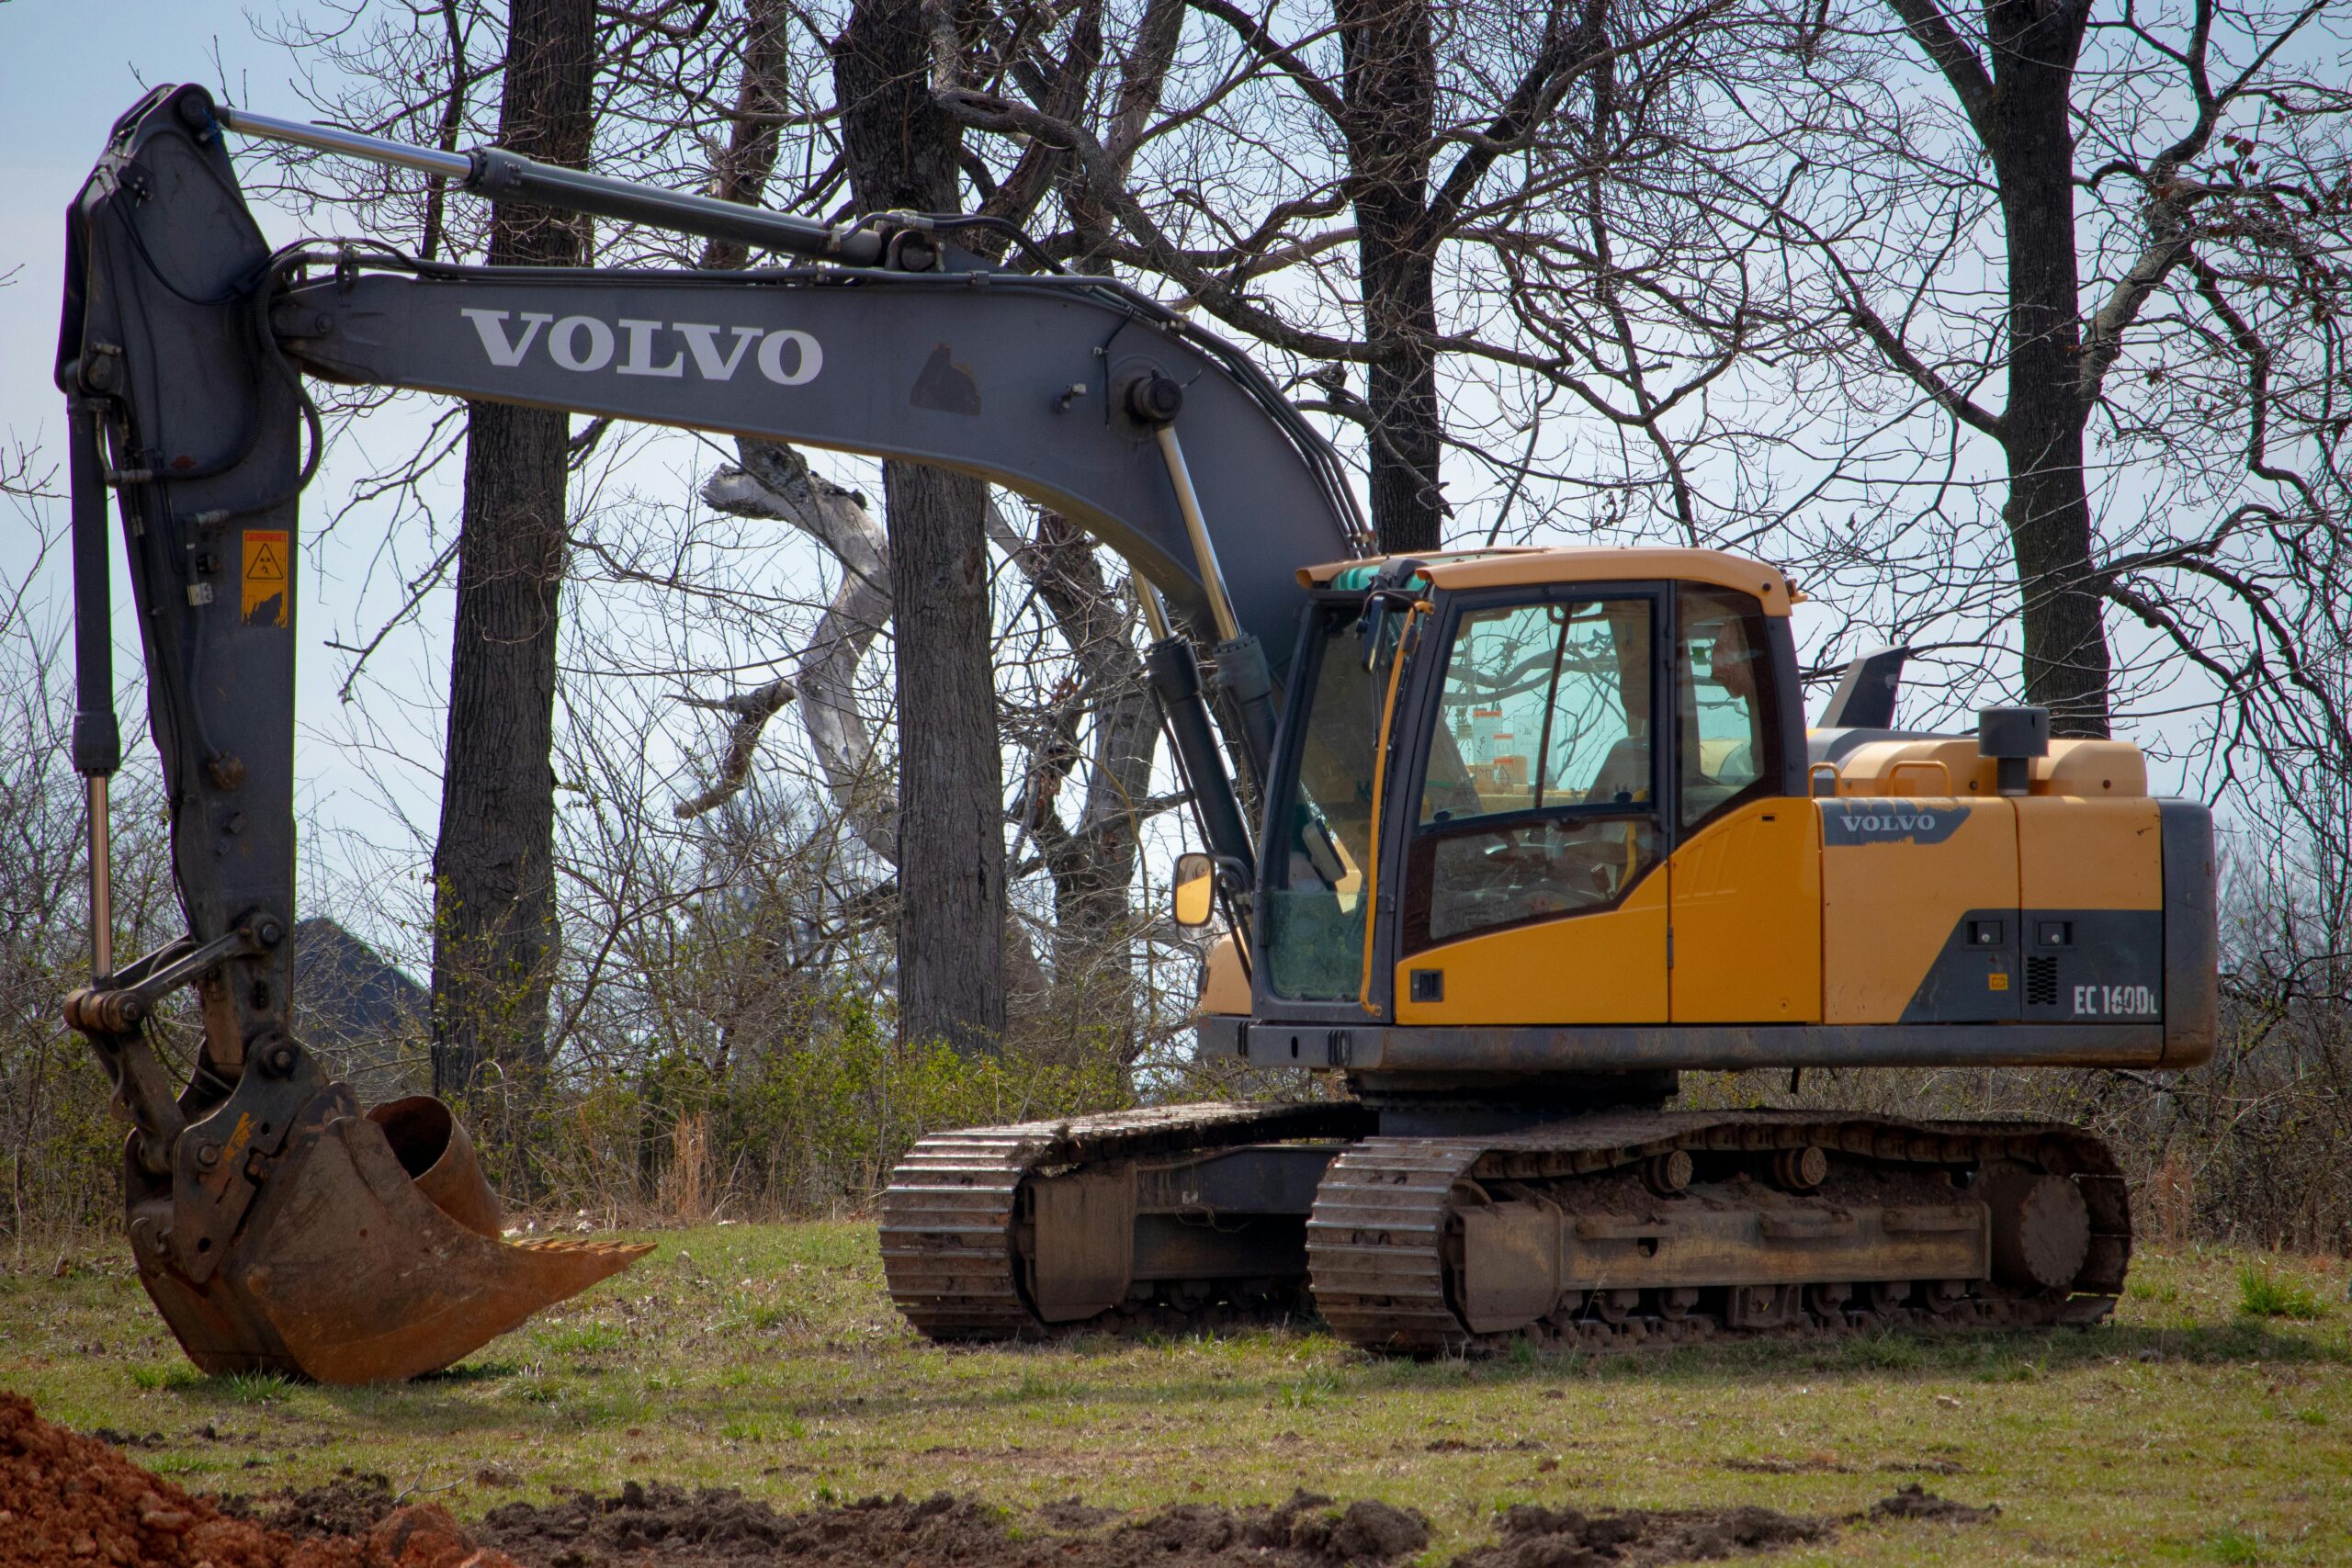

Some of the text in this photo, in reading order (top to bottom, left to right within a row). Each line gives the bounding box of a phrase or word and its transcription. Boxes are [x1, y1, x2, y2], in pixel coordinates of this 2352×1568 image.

[460, 308, 824, 386] VOLVO
[1839, 815, 1936, 832] VOLVO
[2074, 986, 2097, 1014] EC
